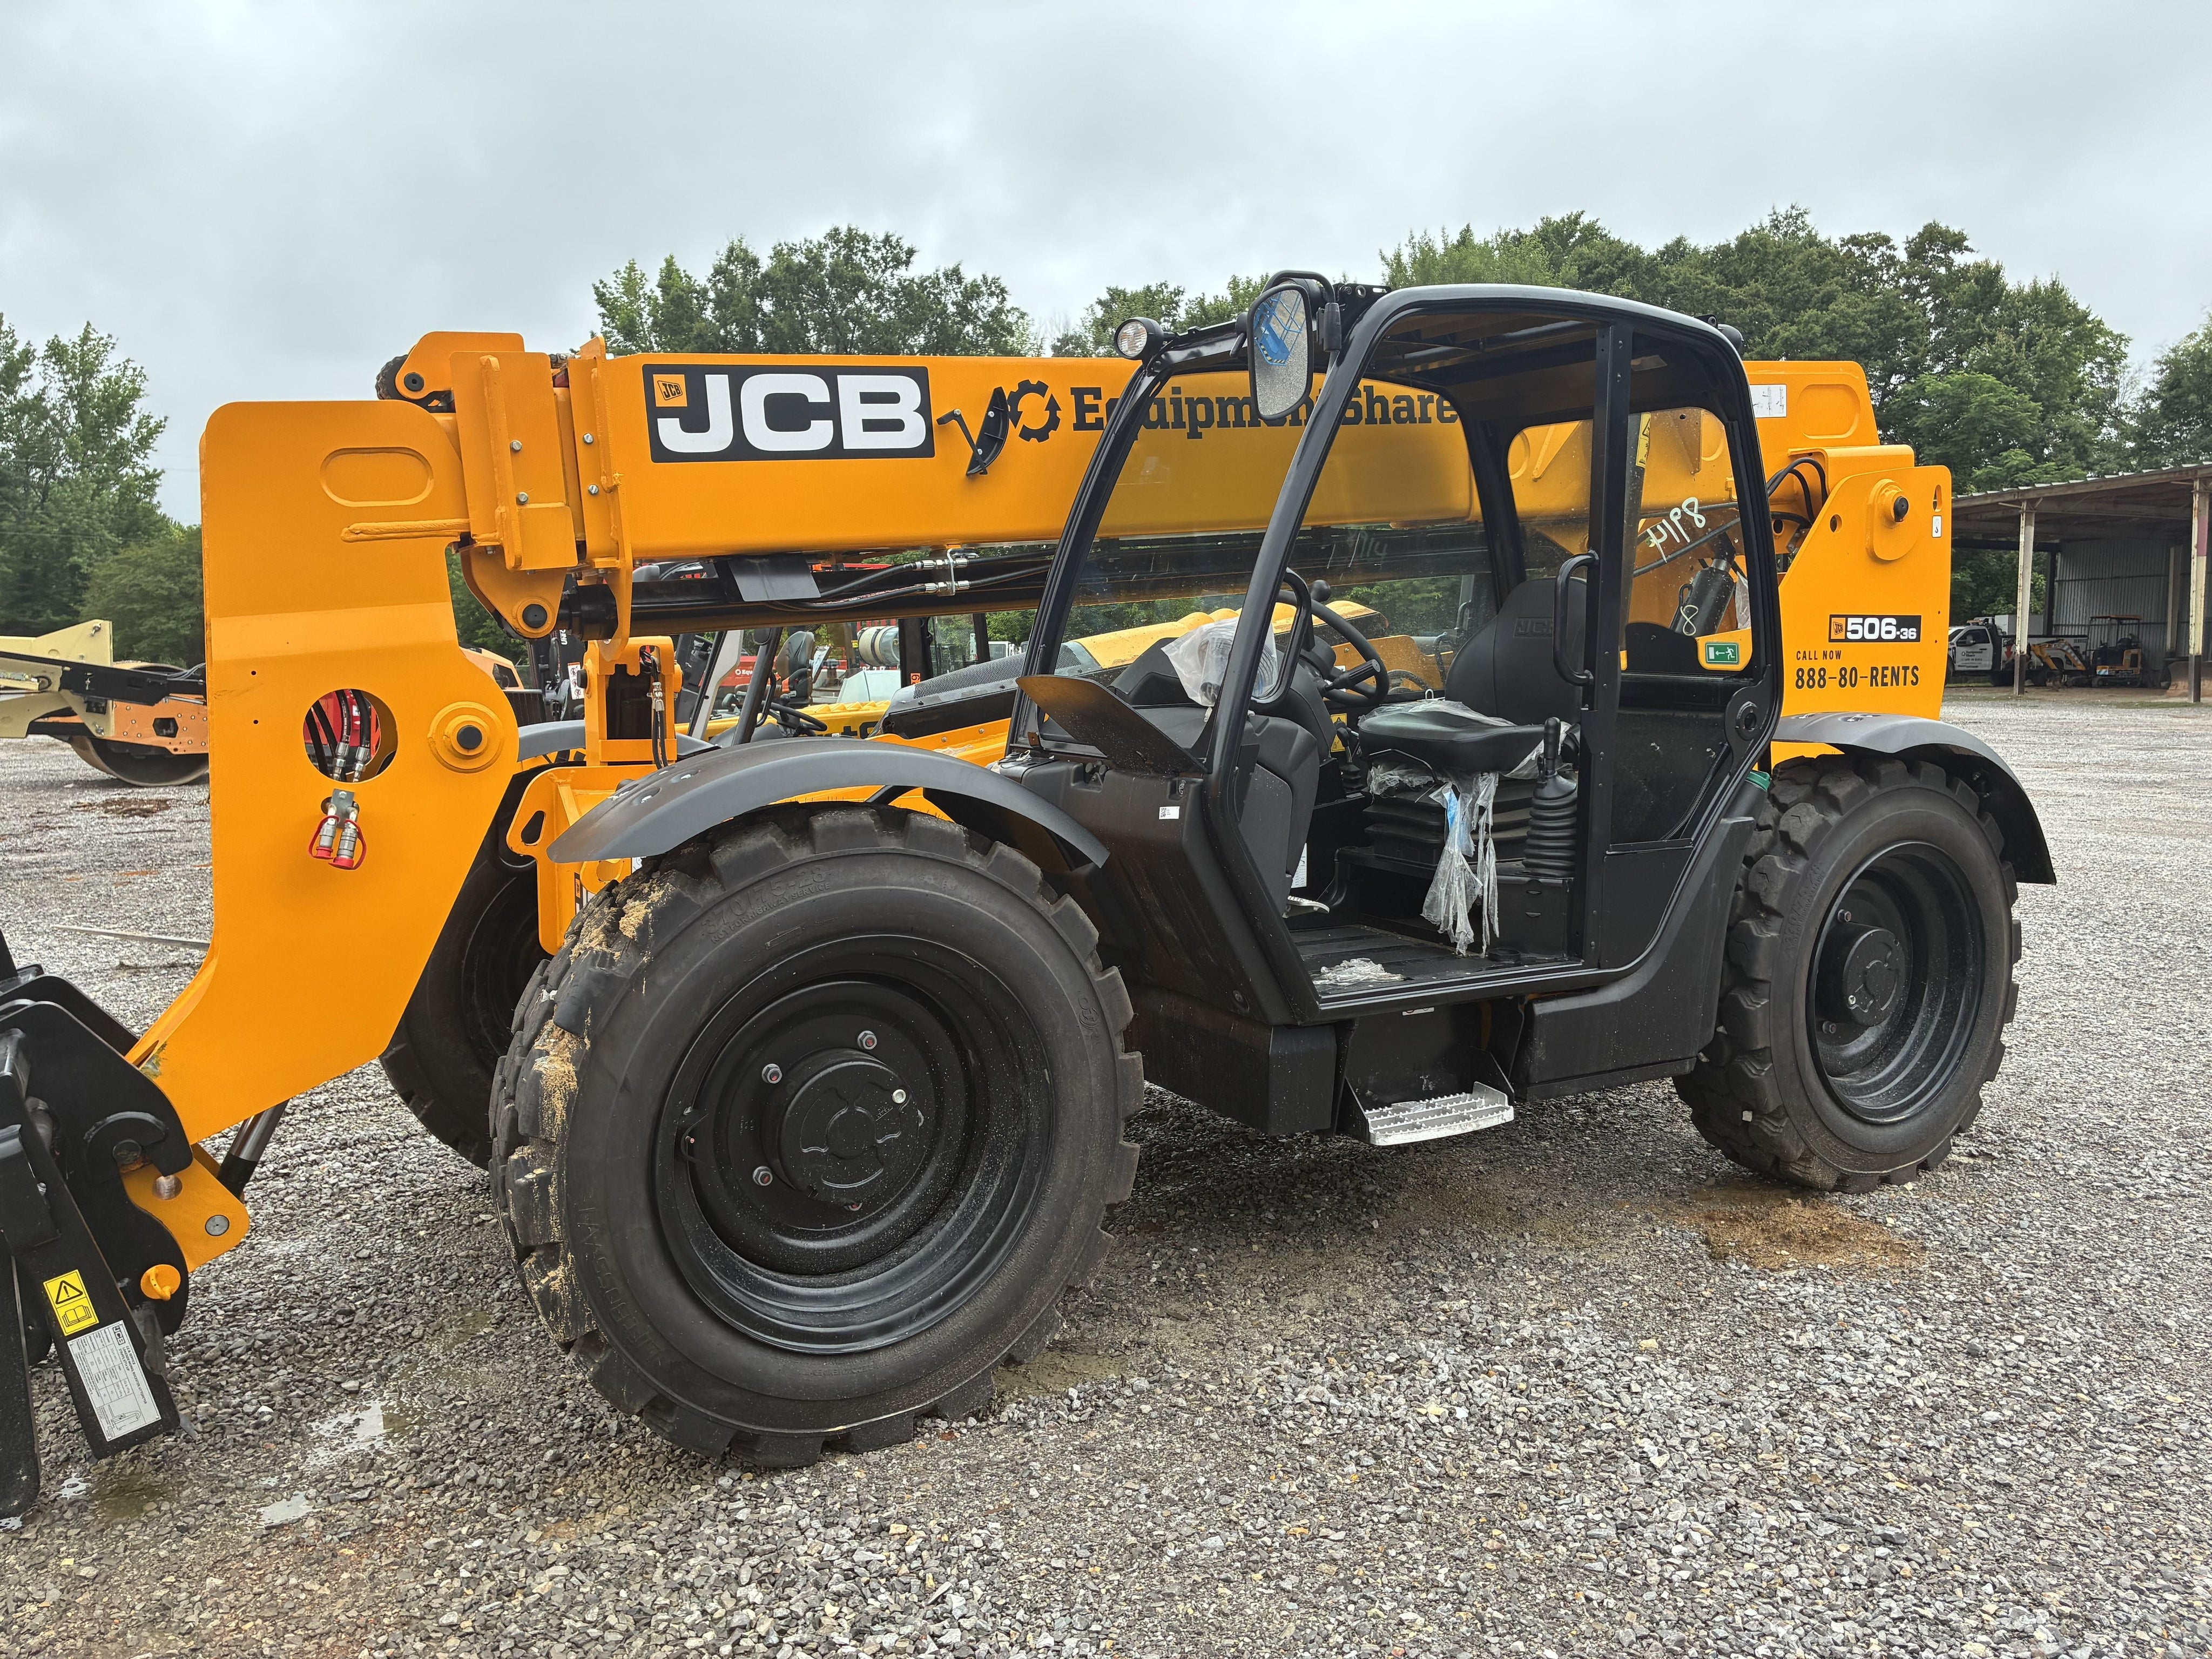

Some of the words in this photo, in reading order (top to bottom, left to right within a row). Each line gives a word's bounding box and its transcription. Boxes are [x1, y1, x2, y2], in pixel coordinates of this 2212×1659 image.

[662, 382, 682, 398] JCB
[657, 373, 927, 453] JCB
[1516, 618, 1553, 636] JC
[1846, 617, 1917, 639] 506-36
[1796, 650, 1818, 660] CALL
[1823, 650, 1842, 660] NOW
[1795, 665, 1920, 690] 888-80-RENTS
[111, 1325, 126, 1346] JCB
